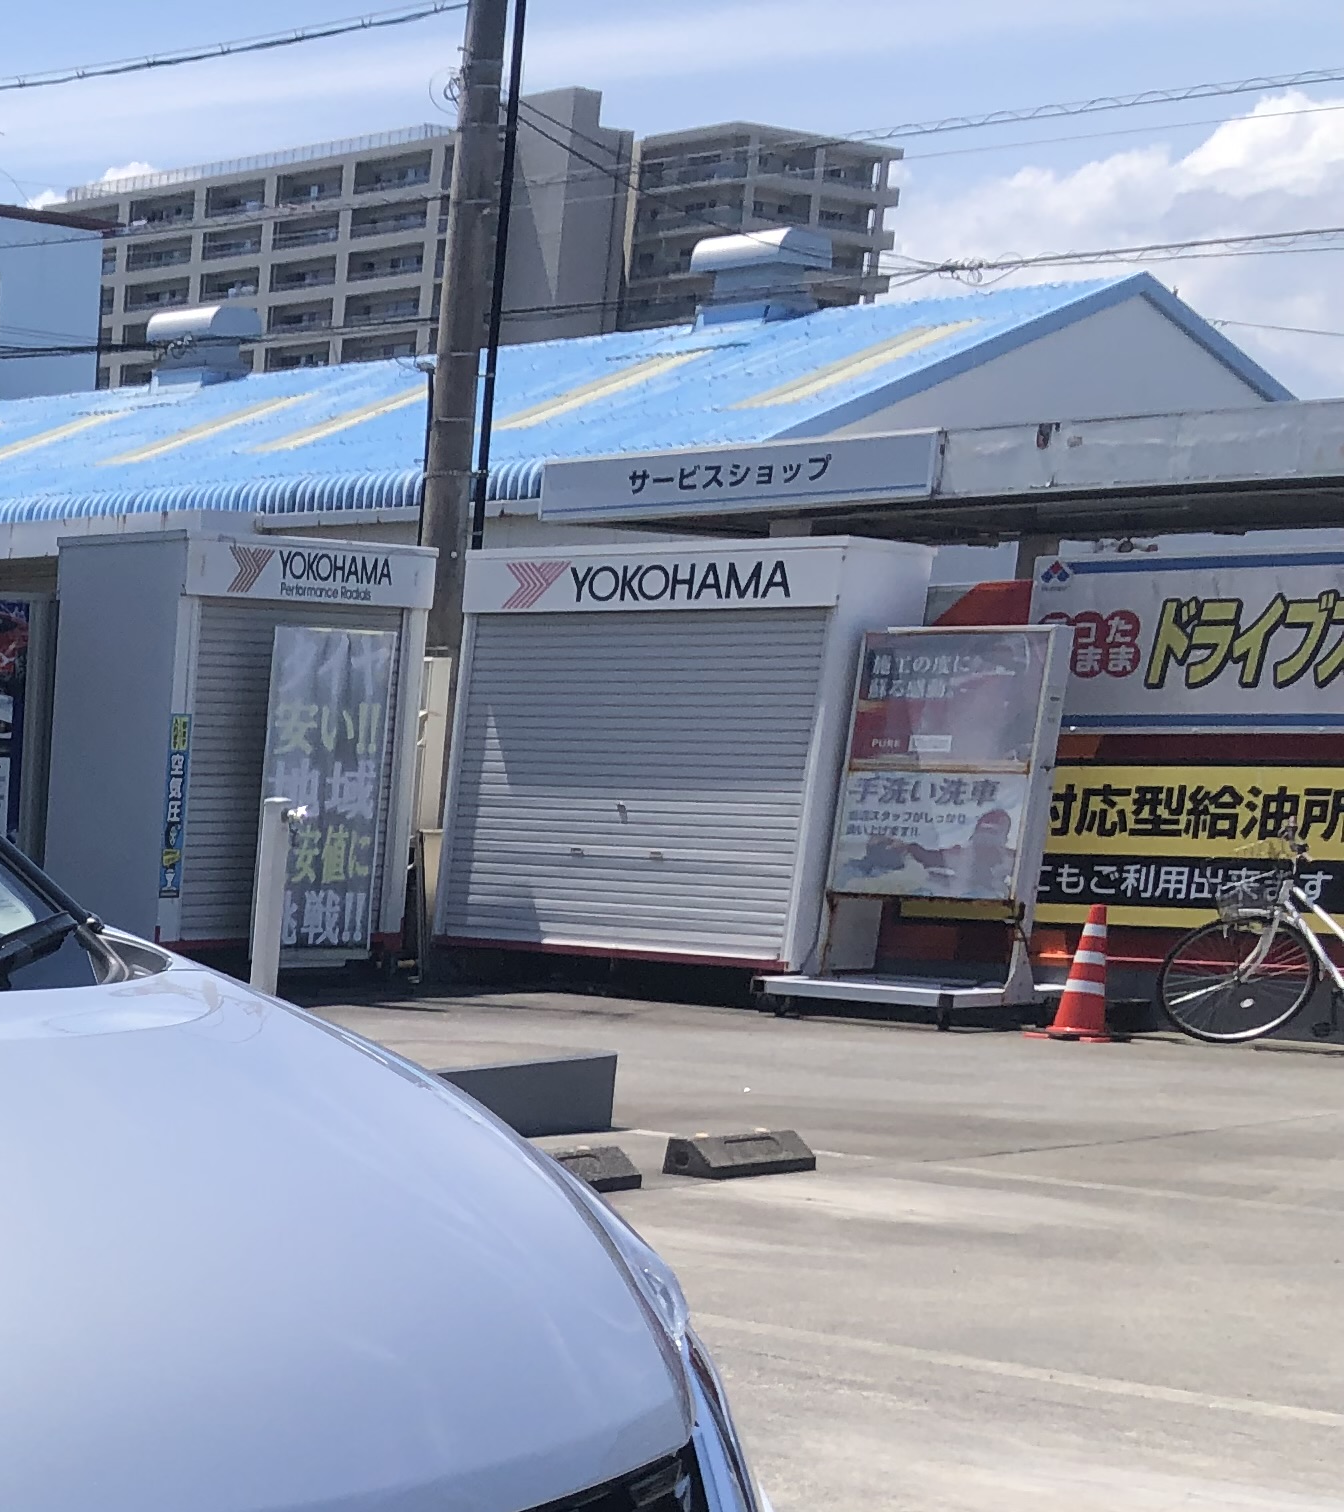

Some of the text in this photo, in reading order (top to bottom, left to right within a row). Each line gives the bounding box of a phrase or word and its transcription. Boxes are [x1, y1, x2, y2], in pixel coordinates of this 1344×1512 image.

[628, 453, 833, 495] サービスショップ
[279, 549, 392, 586] YOKOHAMA
[570, 560, 791, 602] YOKOHAMA
[280, 582, 372, 601] Performance Radials
[291, 824, 372, 885] 安値に
